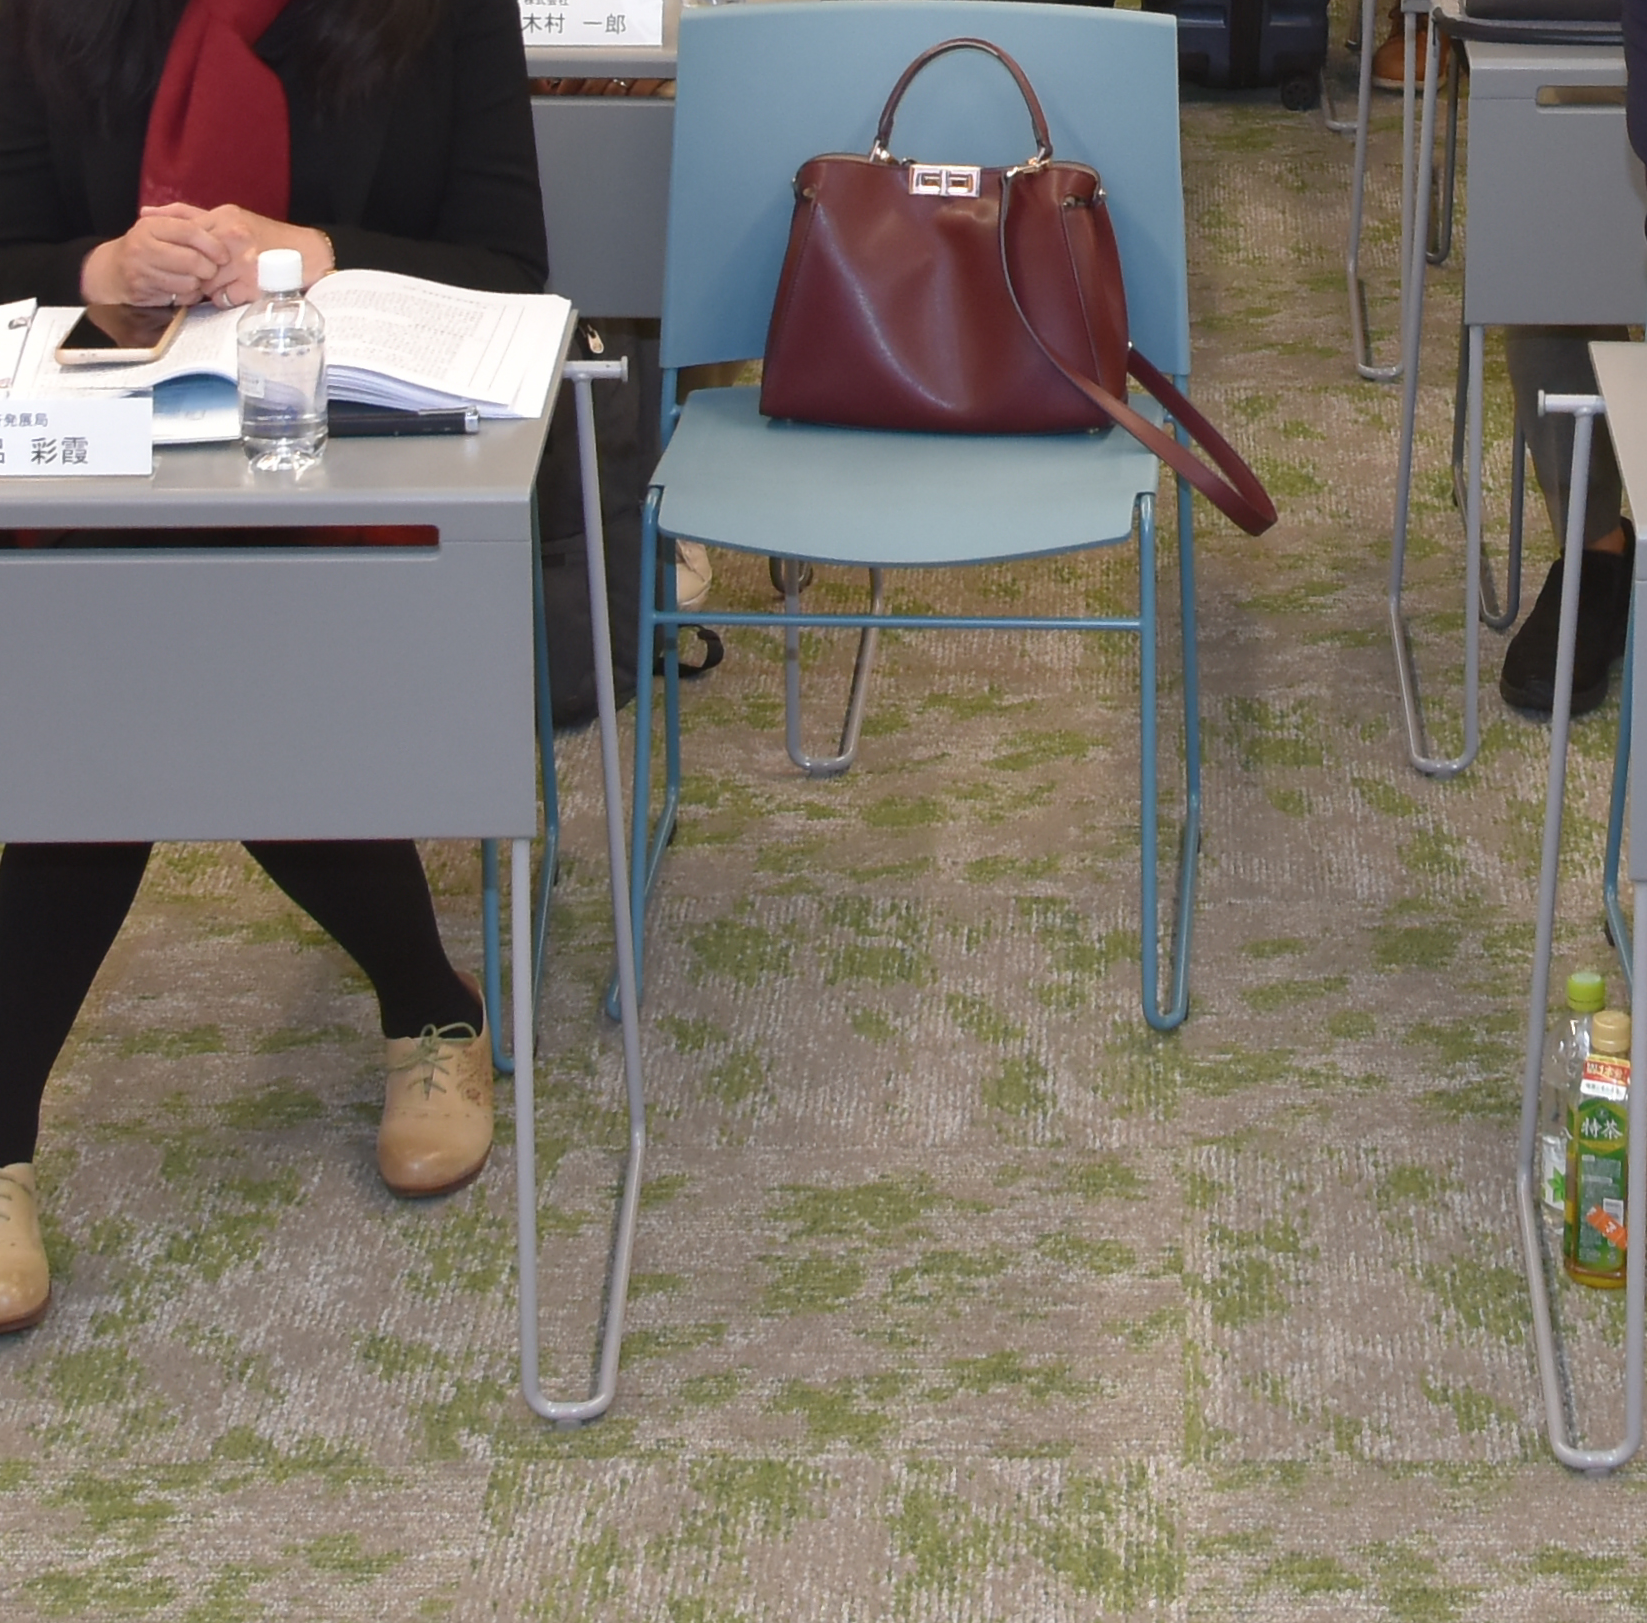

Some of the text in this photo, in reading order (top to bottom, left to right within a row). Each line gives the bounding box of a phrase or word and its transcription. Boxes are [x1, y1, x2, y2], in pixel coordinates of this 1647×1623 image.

[522, 12, 627, 35] 木村 一郎
[30, 437, 89, 465] 彩霞
[1581, 1116, 1623, 1140] 特茶
